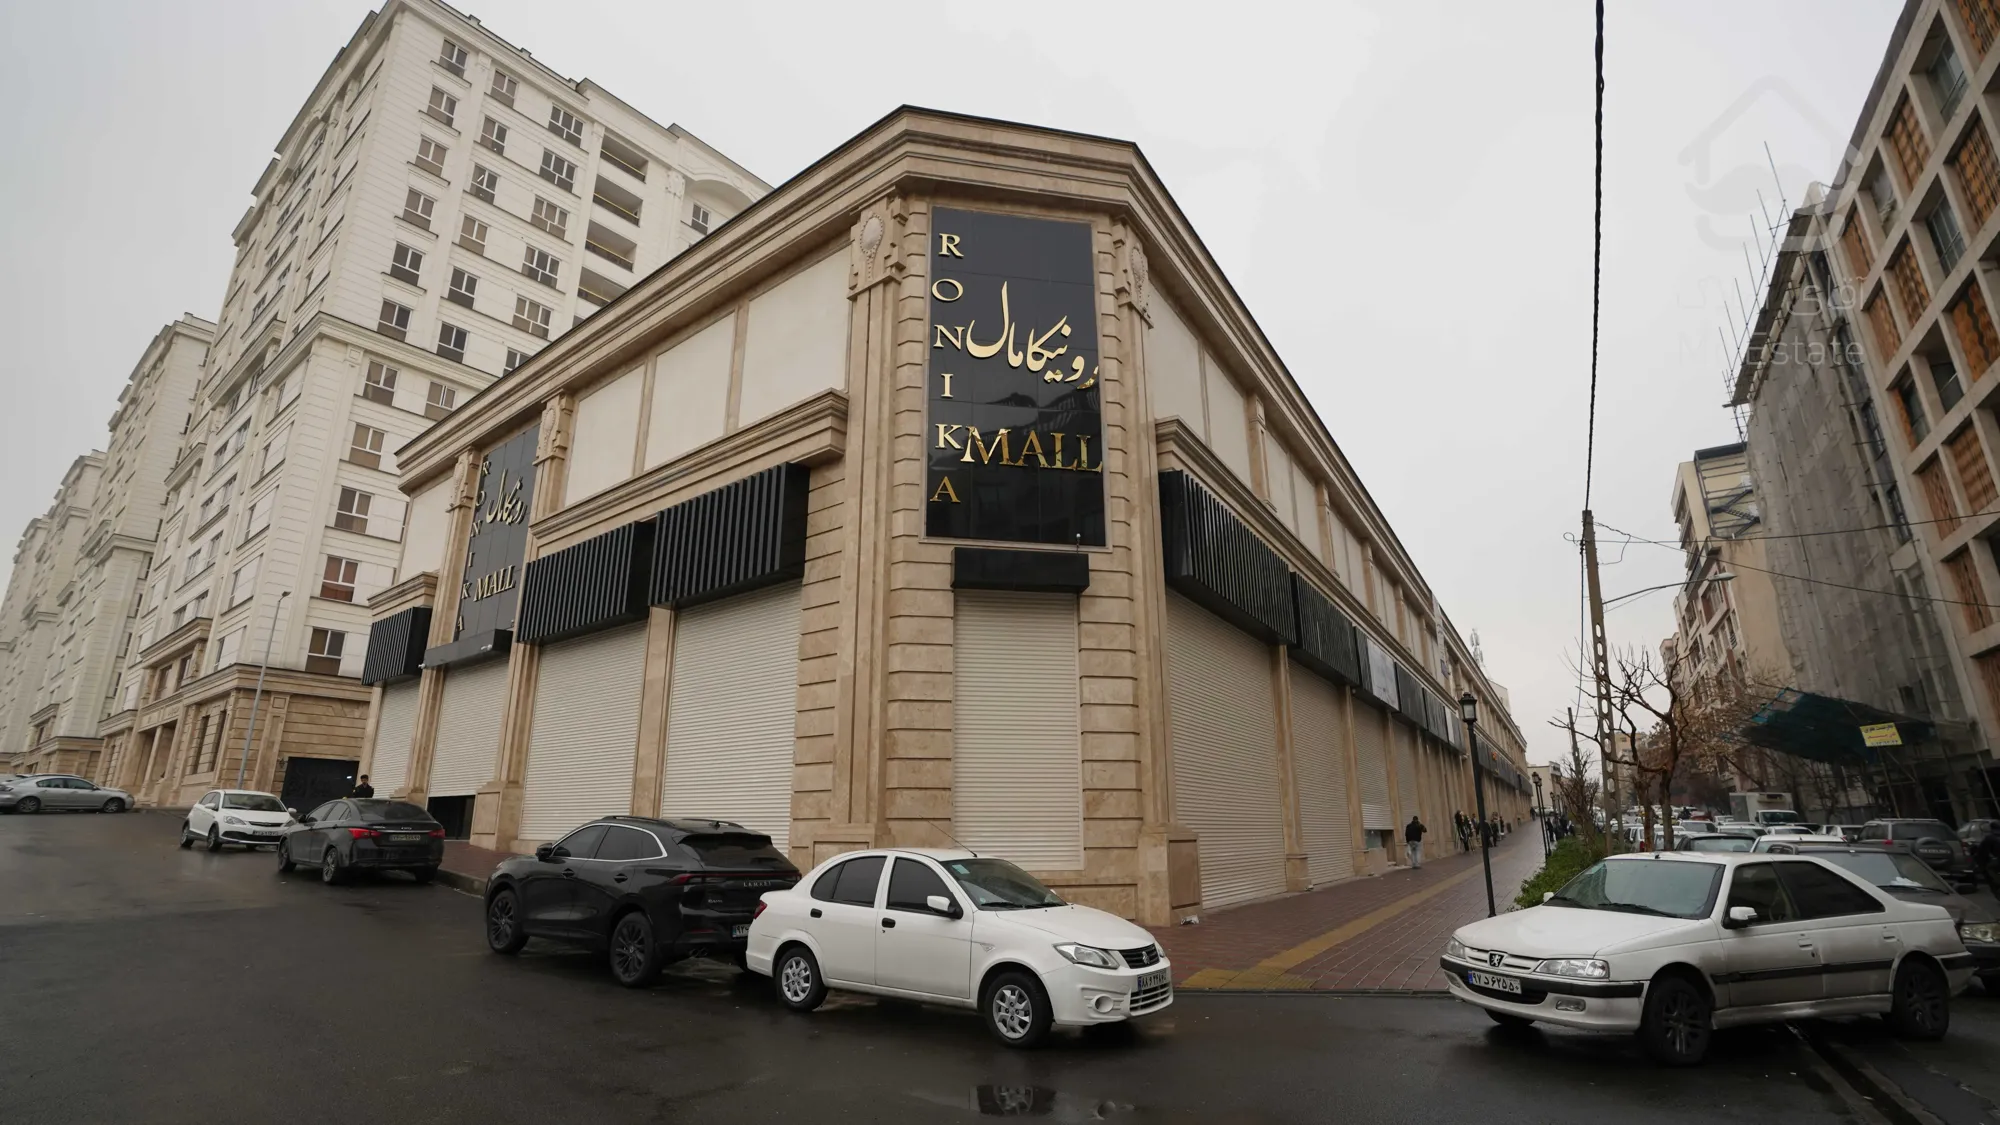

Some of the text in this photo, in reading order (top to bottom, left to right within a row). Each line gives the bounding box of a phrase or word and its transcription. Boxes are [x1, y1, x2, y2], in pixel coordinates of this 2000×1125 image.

[930, 232, 964, 504] RONIKA
[960, 425, 1103, 474] MALL
[473, 564, 516, 602] MALL
